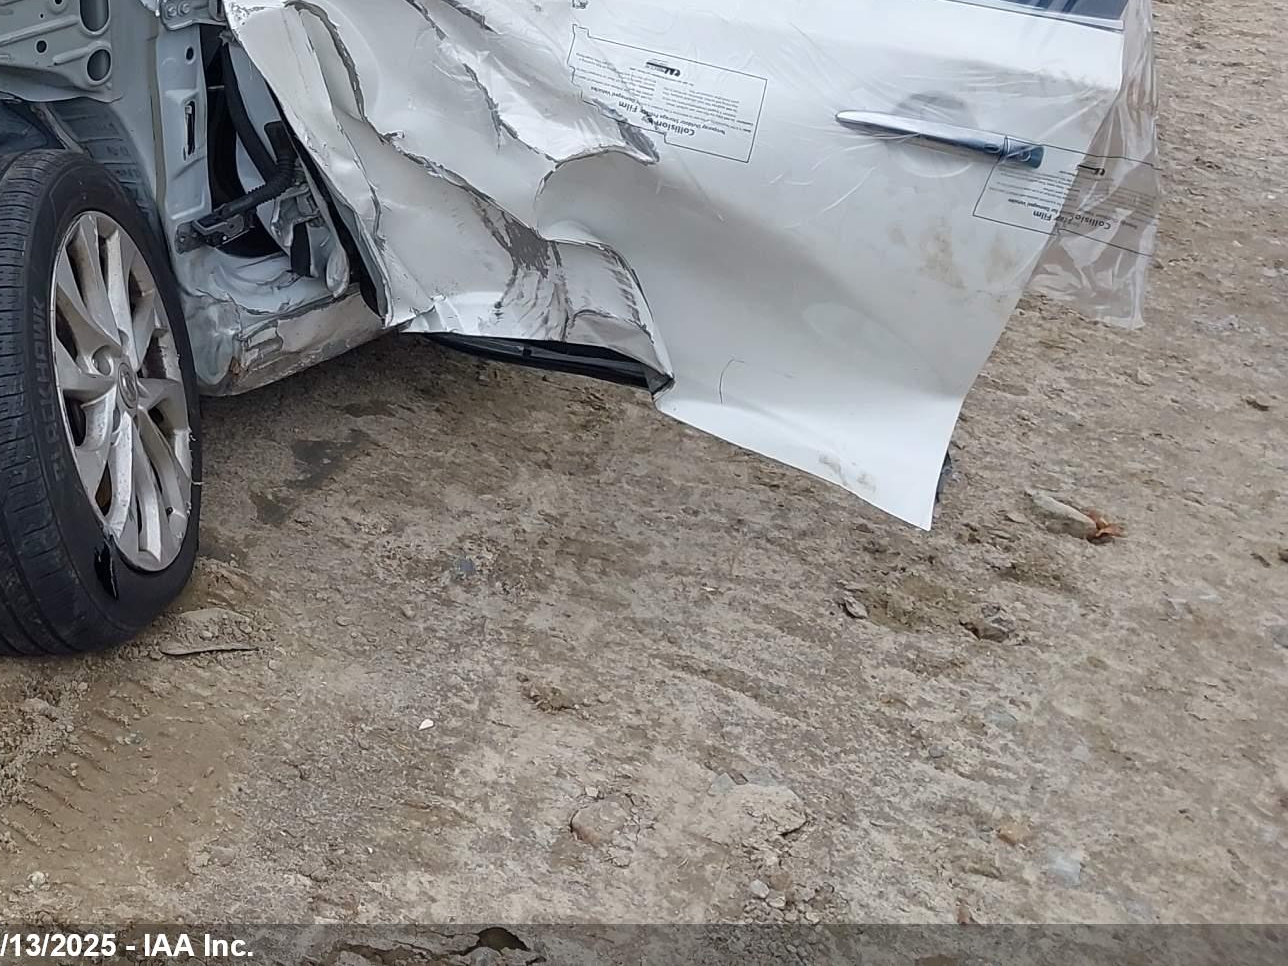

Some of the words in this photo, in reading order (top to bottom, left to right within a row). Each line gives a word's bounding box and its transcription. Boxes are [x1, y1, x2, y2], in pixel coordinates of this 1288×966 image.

[618, 101, 638, 113] Film
[1033, 210, 1052, 221] Film
[1074, 214, 1111, 230] Collisio
